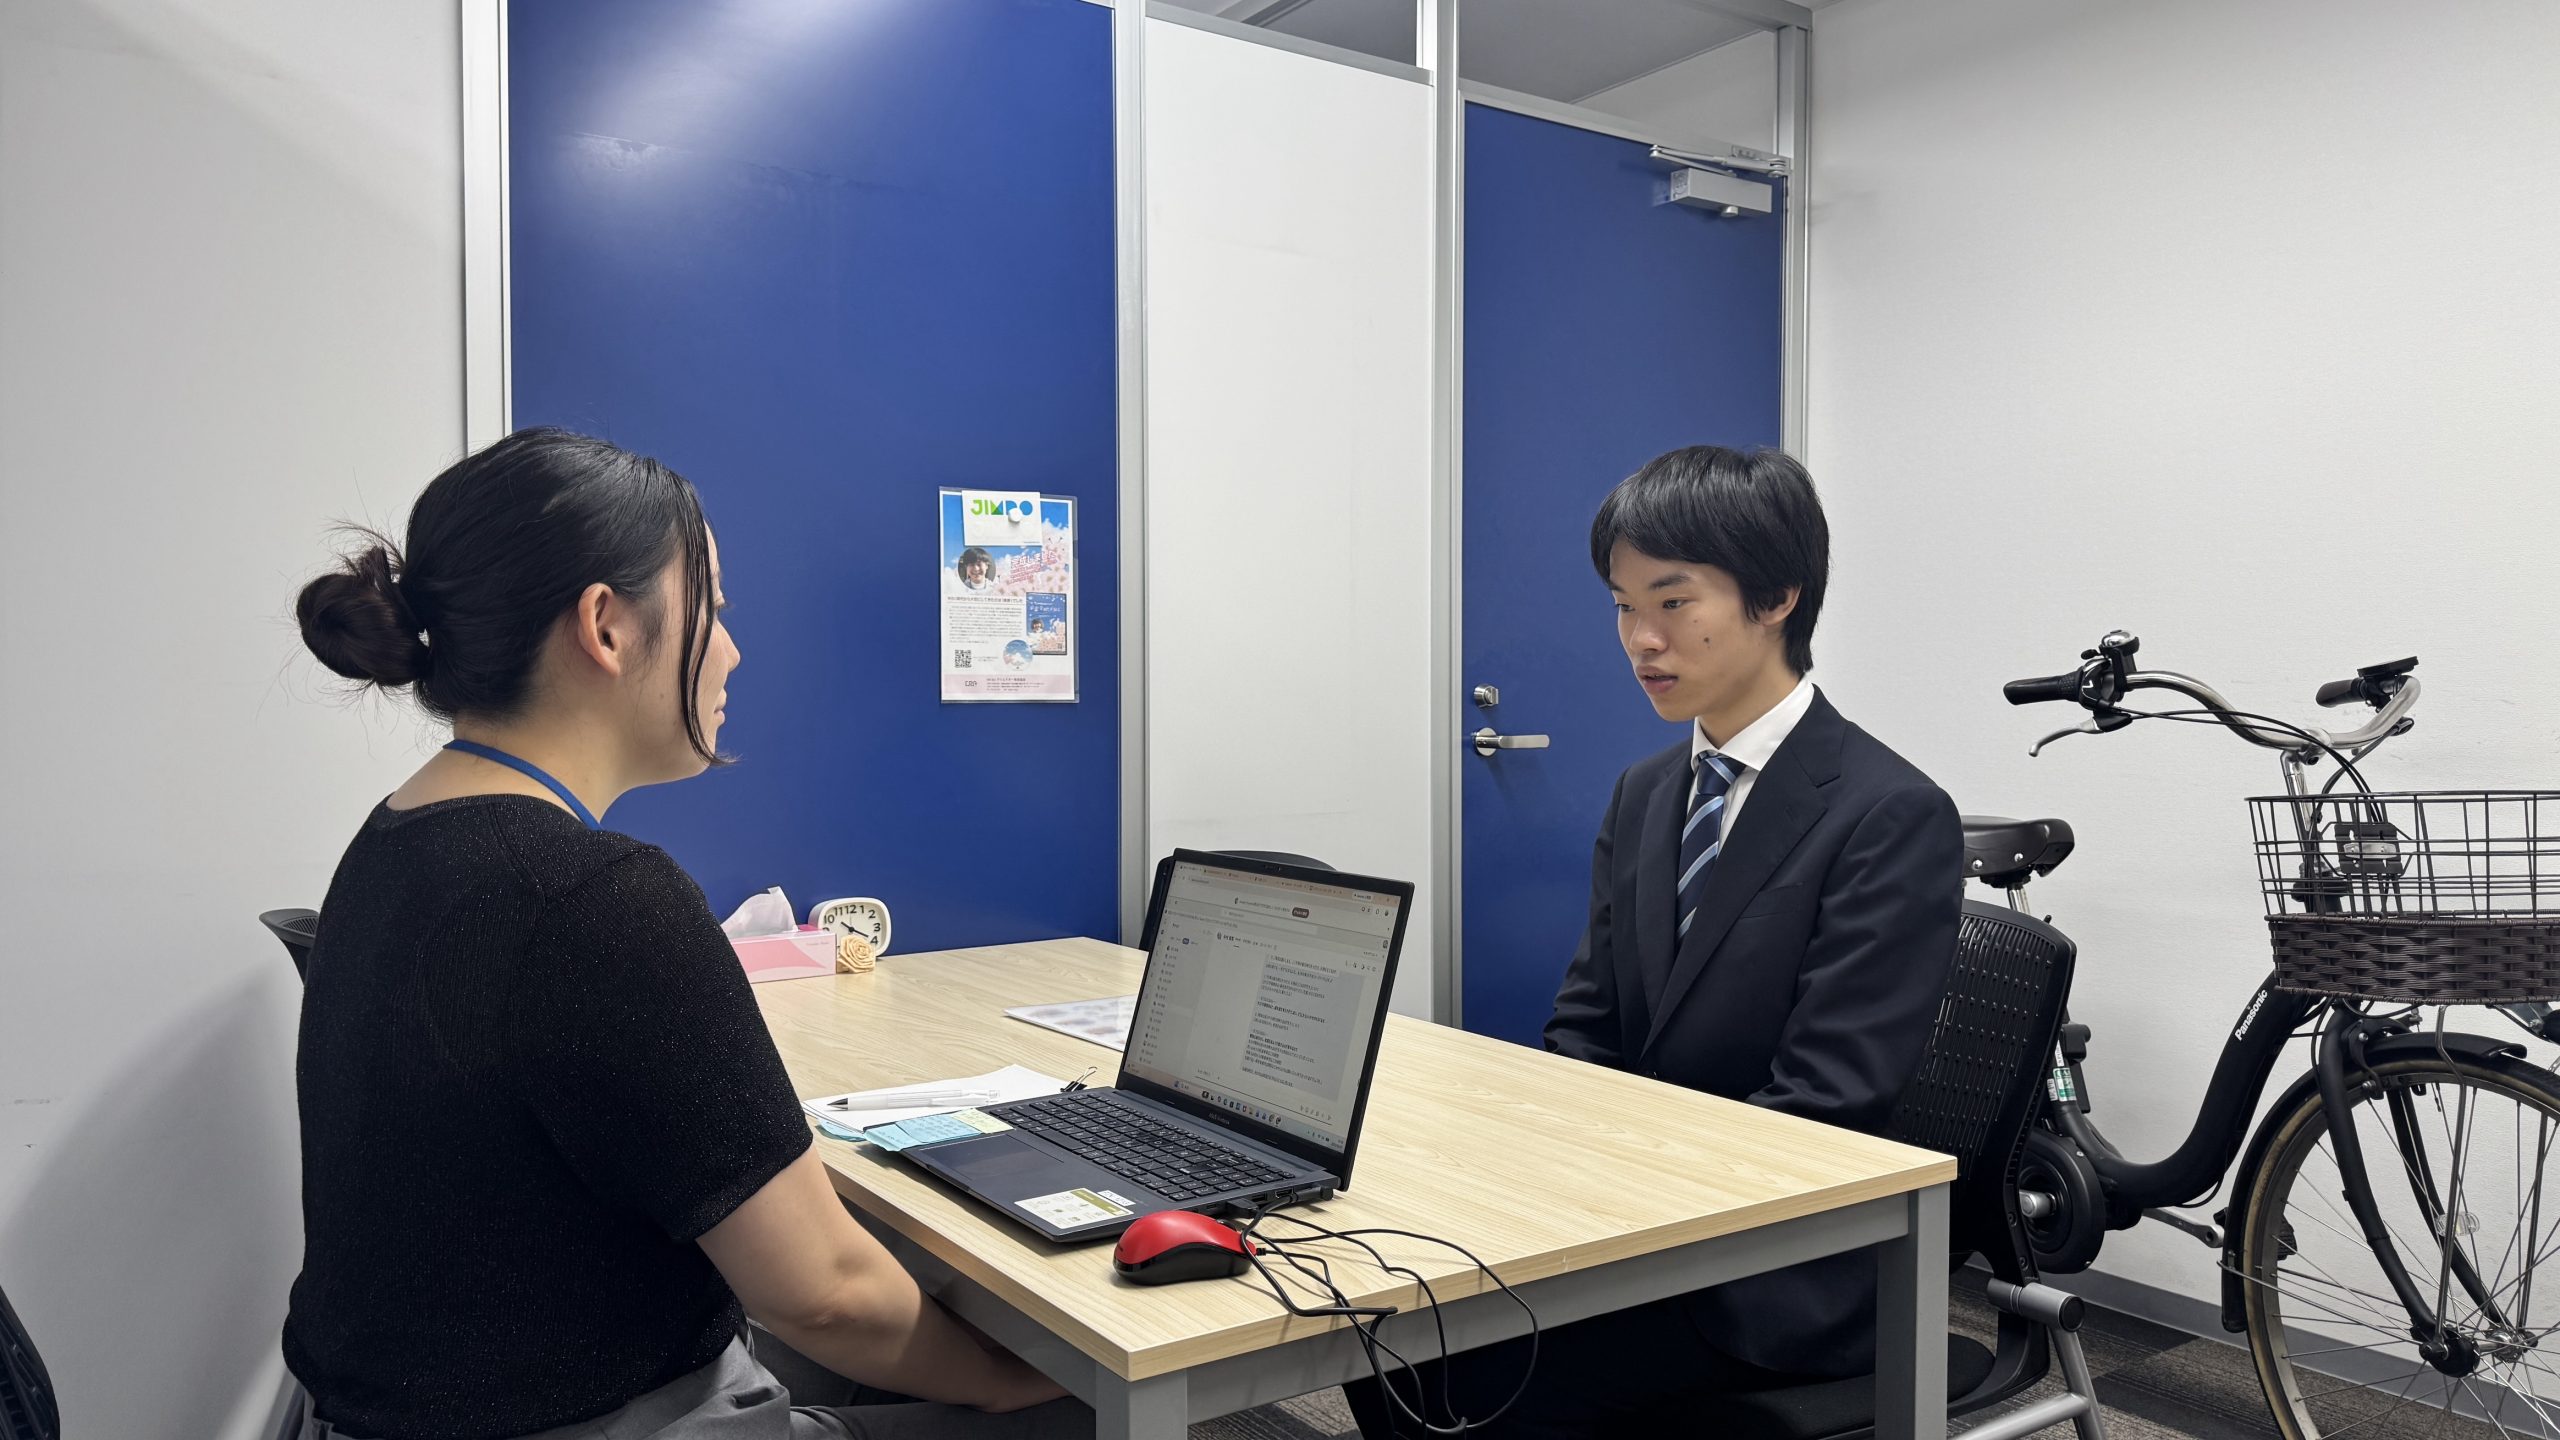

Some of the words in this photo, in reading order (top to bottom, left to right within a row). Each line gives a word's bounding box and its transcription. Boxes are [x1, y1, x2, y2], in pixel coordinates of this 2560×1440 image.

[834, 907, 843, 916] 11
[845, 905, 857, 914] 12
[859, 905, 865, 914] 1
[868, 910, 876, 919] 2
[824, 915, 835, 924] 10
[874, 923, 881, 932] 3
[870, 936, 879, 945] 4
[2234, 989, 2268, 1041] Panasonic
